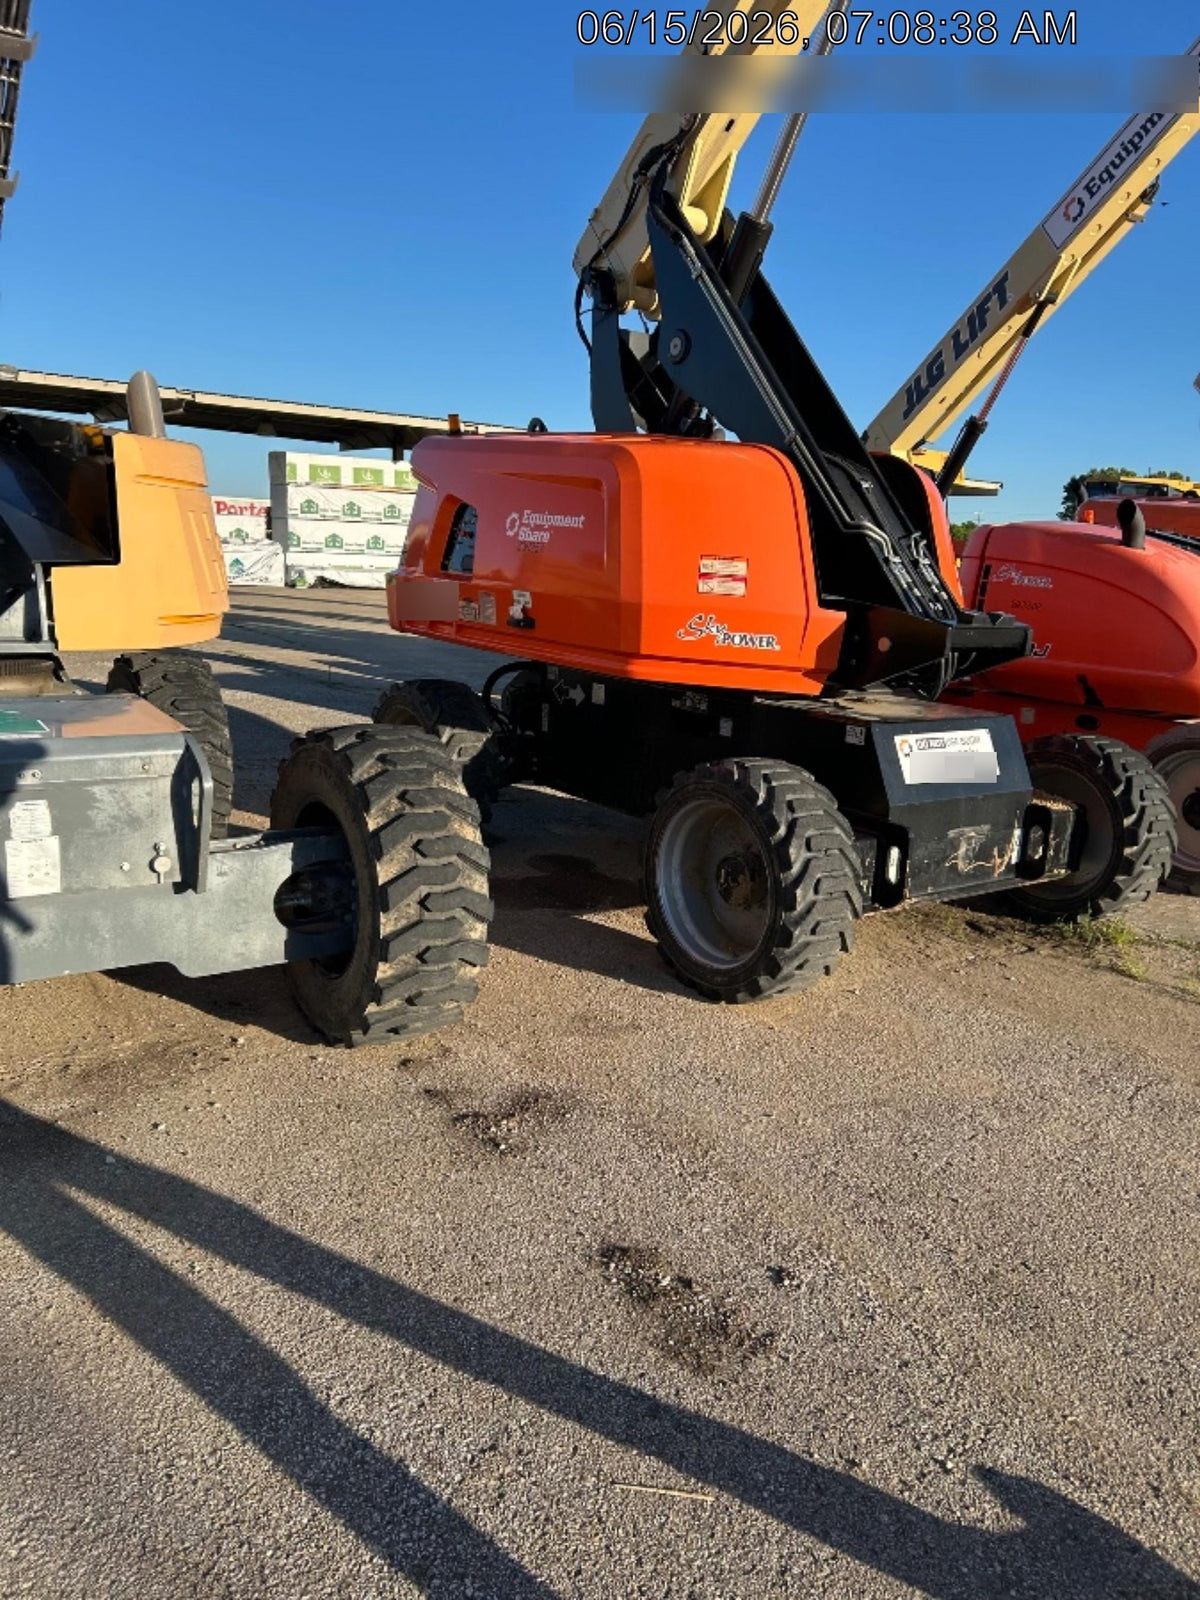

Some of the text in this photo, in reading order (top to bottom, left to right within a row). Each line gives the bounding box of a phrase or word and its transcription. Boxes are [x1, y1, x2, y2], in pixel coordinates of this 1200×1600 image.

[1083, 113, 1165, 200] Equipm
[902, 270, 1009, 421] JLG LIFT
[522, 510, 586, 529] Equipment
[518, 526, 550, 543] Share
[677, 613, 728, 641] Sky
[719, 632, 780, 651] POWER
